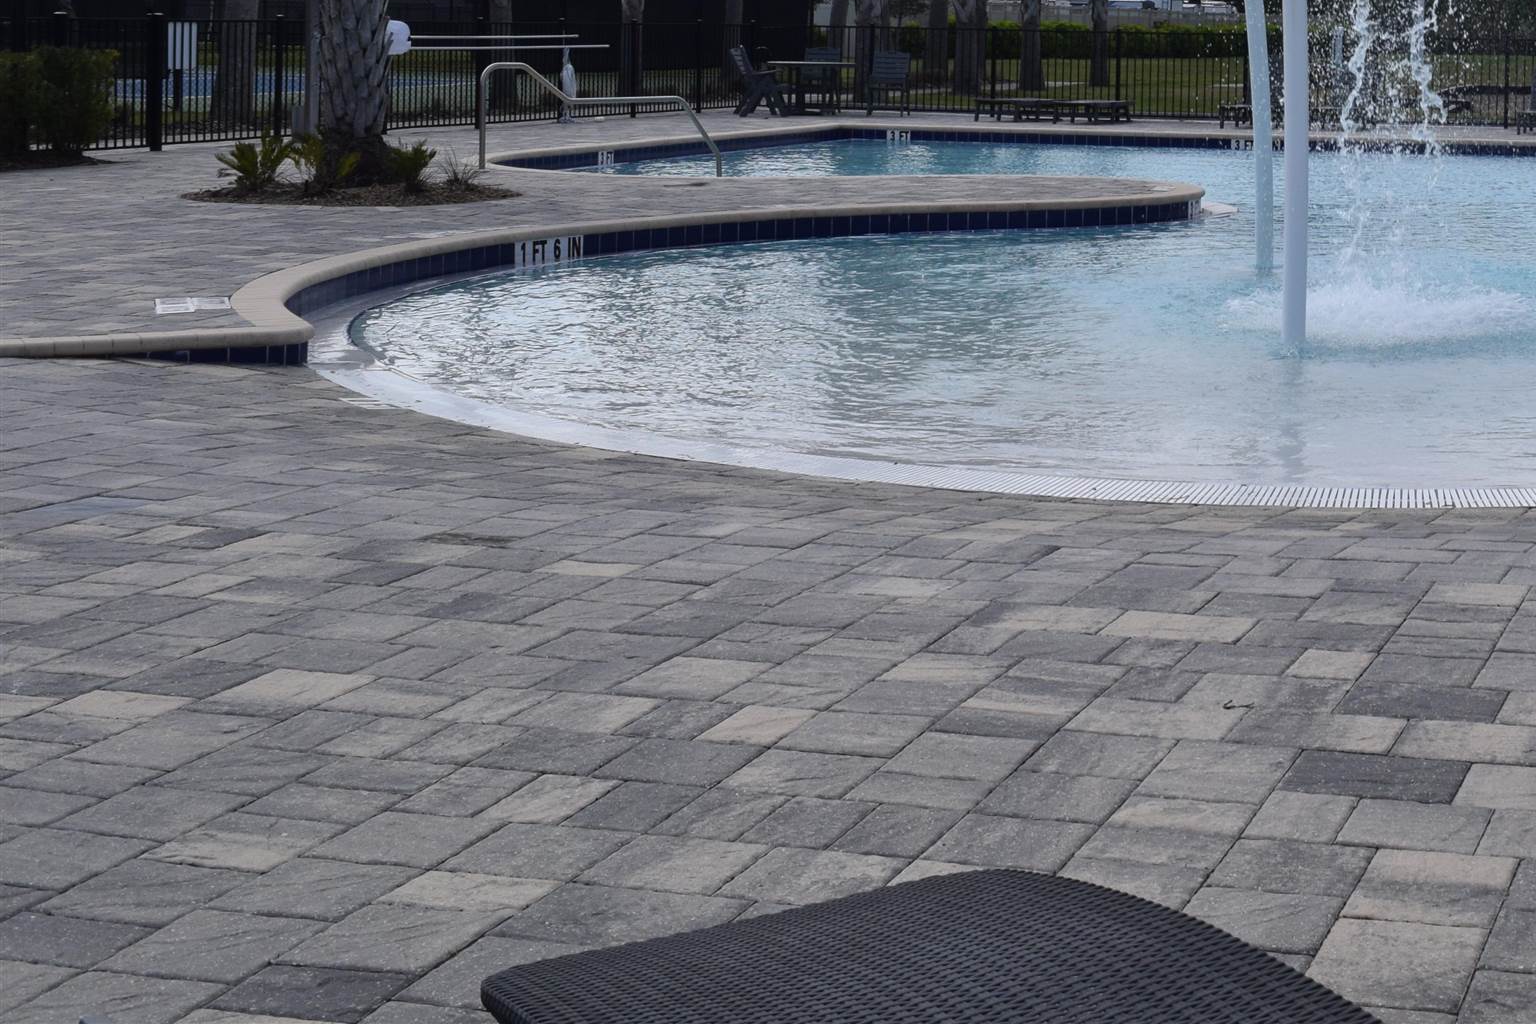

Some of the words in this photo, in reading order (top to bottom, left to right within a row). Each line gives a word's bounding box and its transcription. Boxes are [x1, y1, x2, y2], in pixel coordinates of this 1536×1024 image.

[890, 130, 896, 141] 3
[899, 130, 909, 143] FT
[1234, 139, 1241, 151] 3
[520, 242, 526, 267] 1
[532, 239, 548, 265] FT
[553, 238, 562, 262] 6
[567, 236, 582, 260] IN
